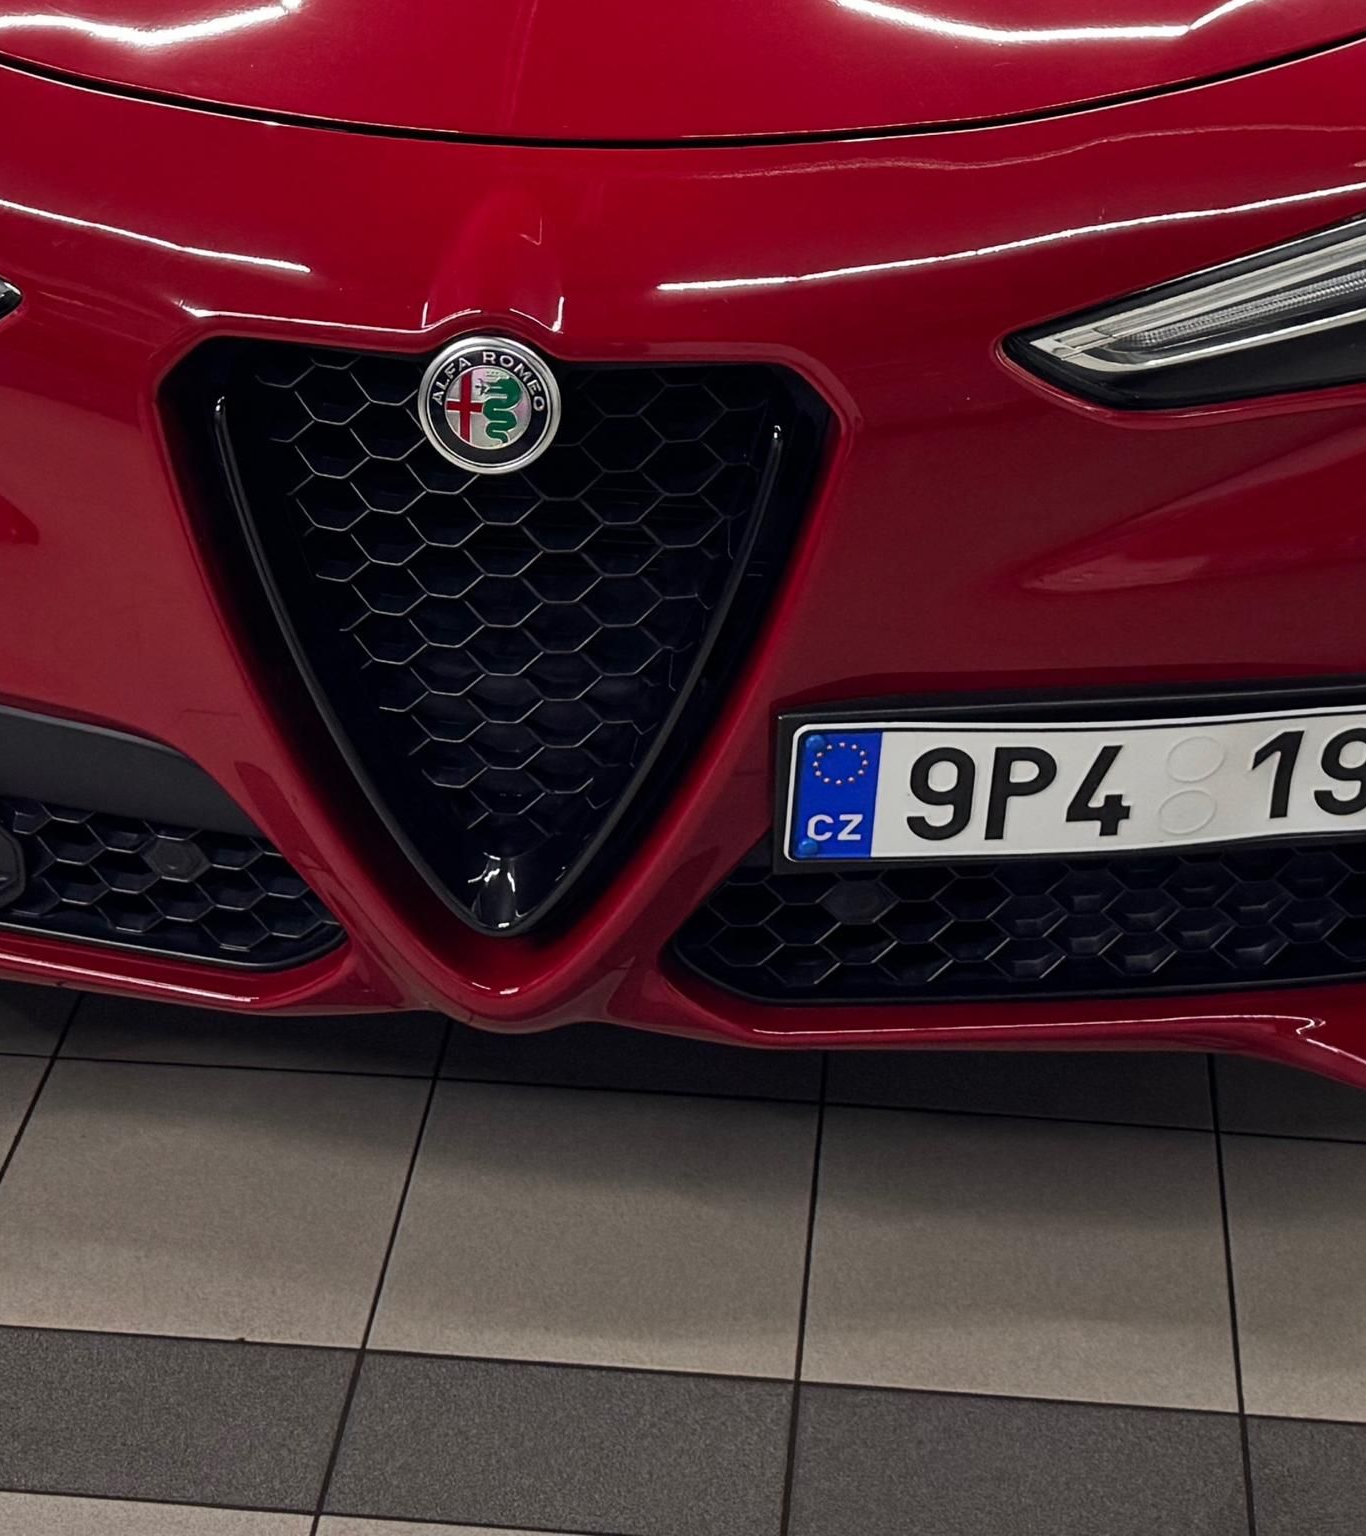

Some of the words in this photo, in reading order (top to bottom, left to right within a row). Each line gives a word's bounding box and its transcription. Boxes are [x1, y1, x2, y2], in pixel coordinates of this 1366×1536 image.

[432, 357, 471, 406] ALFA
[482, 351, 545, 411] ROMEO
[906, 745, 1131, 840] 9P4
[806, 814, 862, 842] CZ
